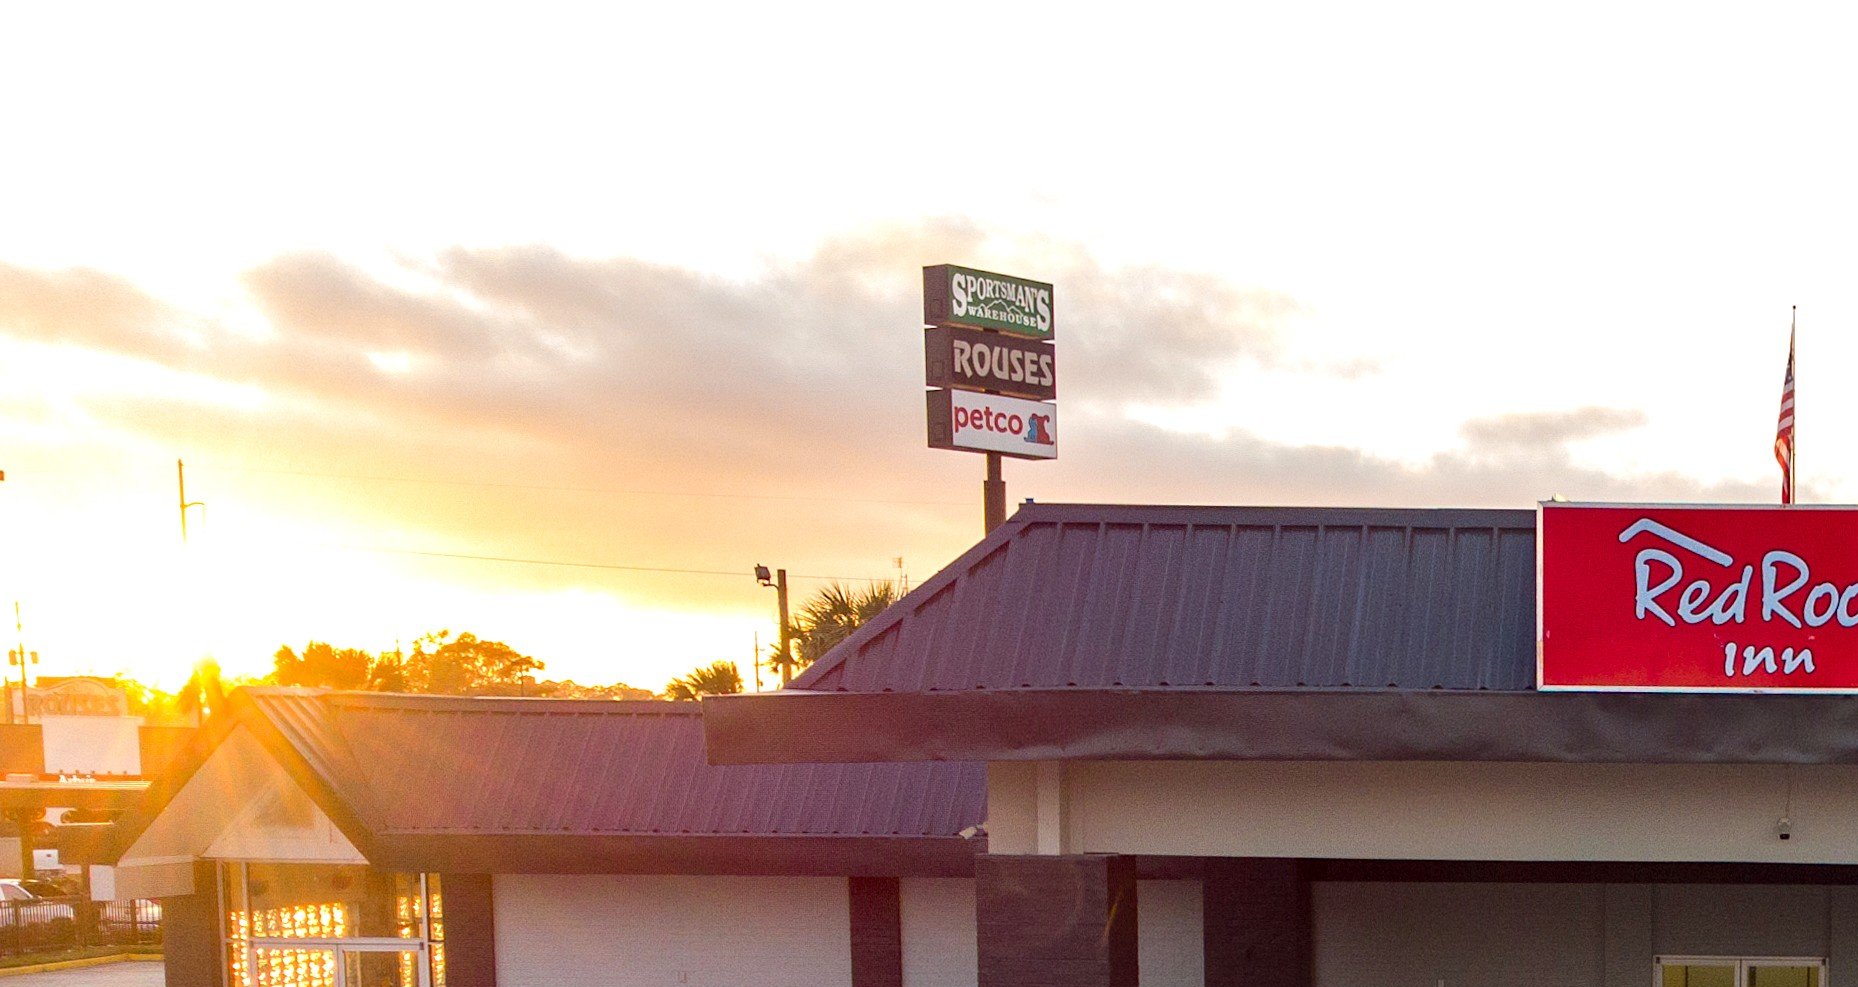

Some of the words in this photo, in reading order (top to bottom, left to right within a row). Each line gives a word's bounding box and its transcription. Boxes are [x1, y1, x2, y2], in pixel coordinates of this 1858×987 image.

[952, 273, 1051, 331] SPORTSMAN'S
[967, 305, 1037, 327] WAREHOUSE
[953, 339, 1052, 387] ROUSES
[953, 405, 1024, 435] petco
